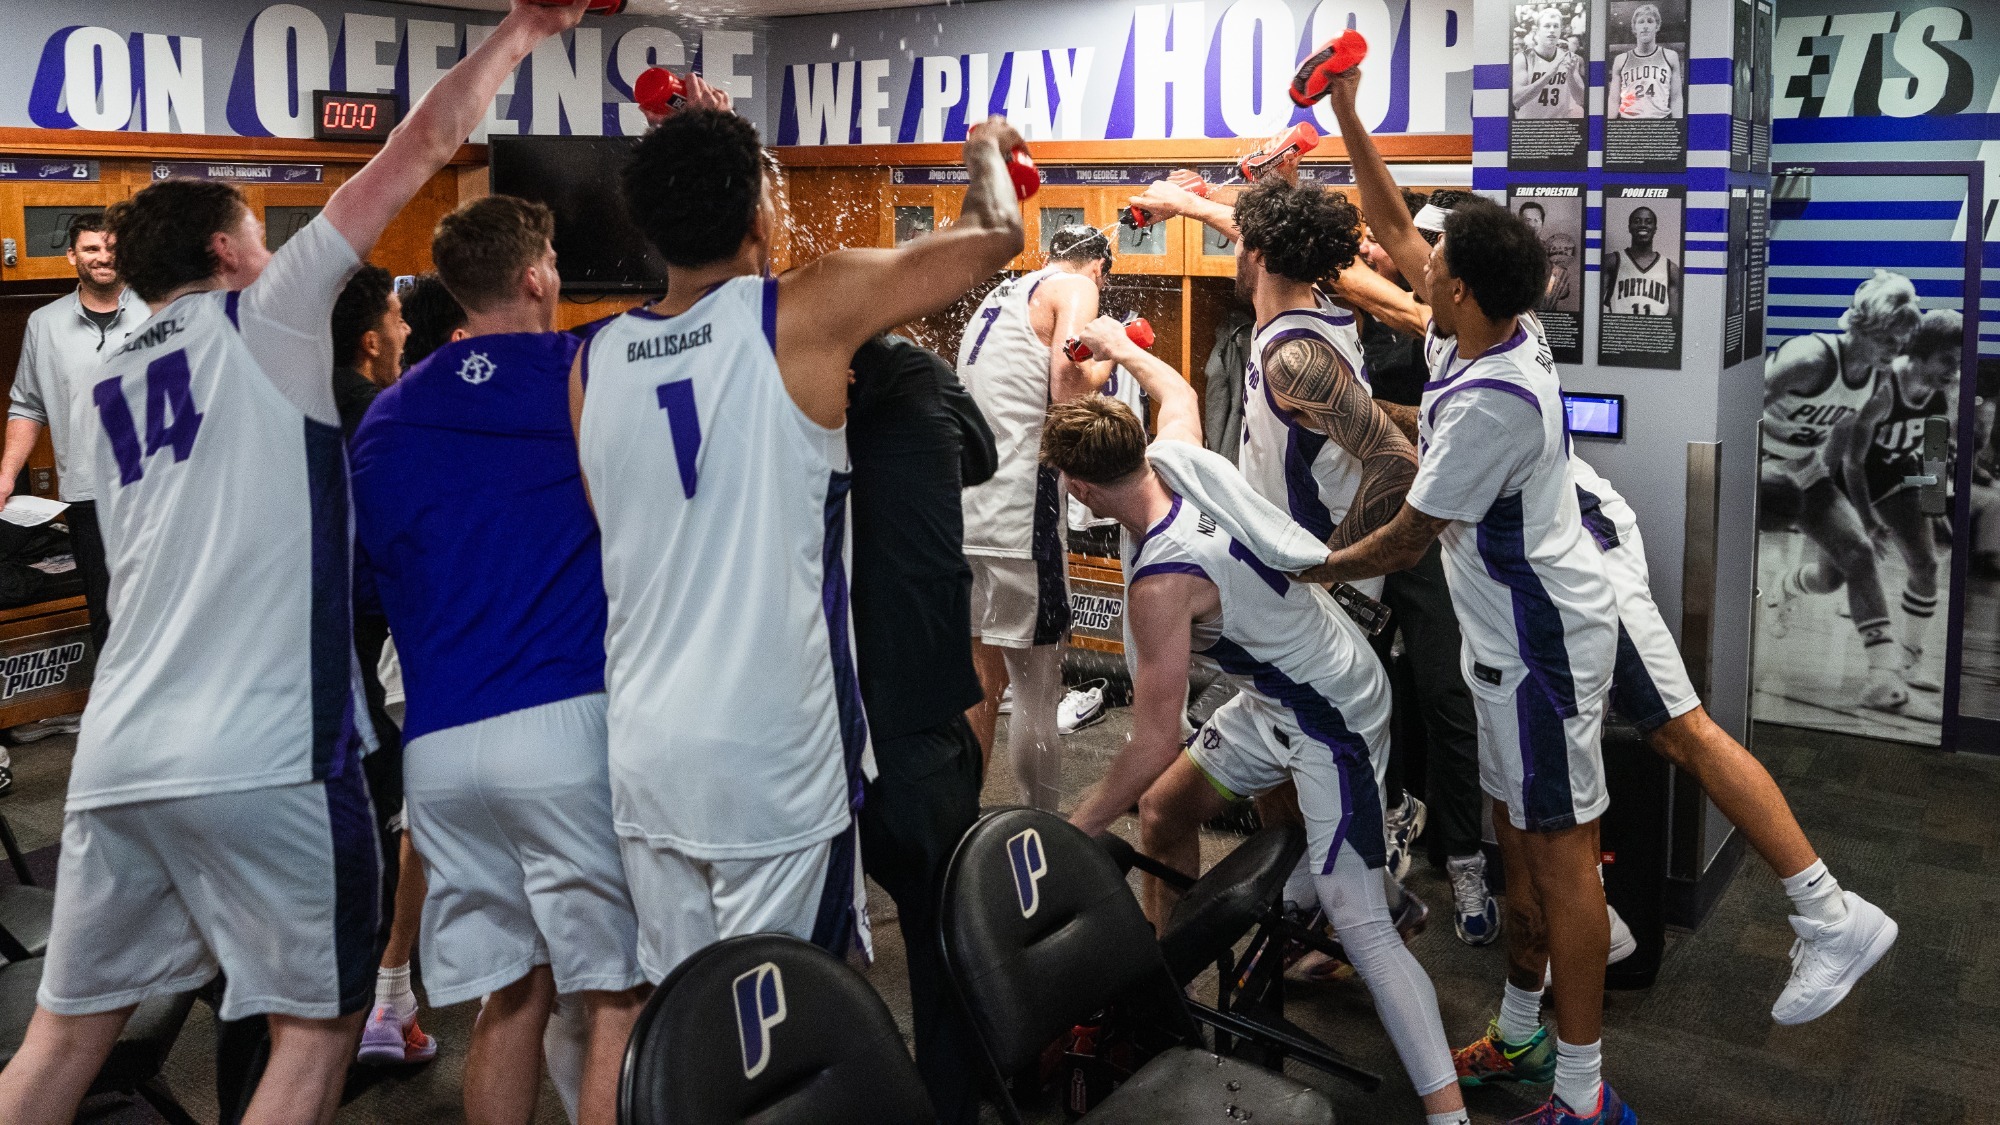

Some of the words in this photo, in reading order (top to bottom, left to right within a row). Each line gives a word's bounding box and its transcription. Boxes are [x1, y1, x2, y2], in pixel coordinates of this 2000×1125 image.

[62, 26, 204, 133] ON
[1530, 71, 1567, 86] POTS
[1622, 65, 1668, 90] PILOTS
[792, 59, 891, 146] WE
[922, 47, 1096, 143] PLAY
[1537, 87, 1560, 107] 43
[1634, 83, 1656, 99] 24
[72, 163, 88, 178] 23
[315, 168, 322, 181] 7
[1076, 169, 1092, 180] TIMO
[1092, 169, 1119, 180] GEORGE
[1515, 187, 1535, 197] ERIK
[1534, 187, 1579, 197] SPOELSTRA
[1621, 187, 1645, 198] POOH
[1644, 188, 1669, 198] JETER
[1617, 277, 1667, 305] PORTLAND
[626, 322, 713, 364] BALLISAGER
[966, 305, 1002, 366] 7
[93, 347, 204, 487] 14
[1787, 404, 1857, 426] PILO
[655, 377, 706, 500] 1
[1071, 594, 1122, 616] ORTLAND
[1072, 609, 1110, 629] PILOTS
[6, 664, 67, 698] PILOTS
